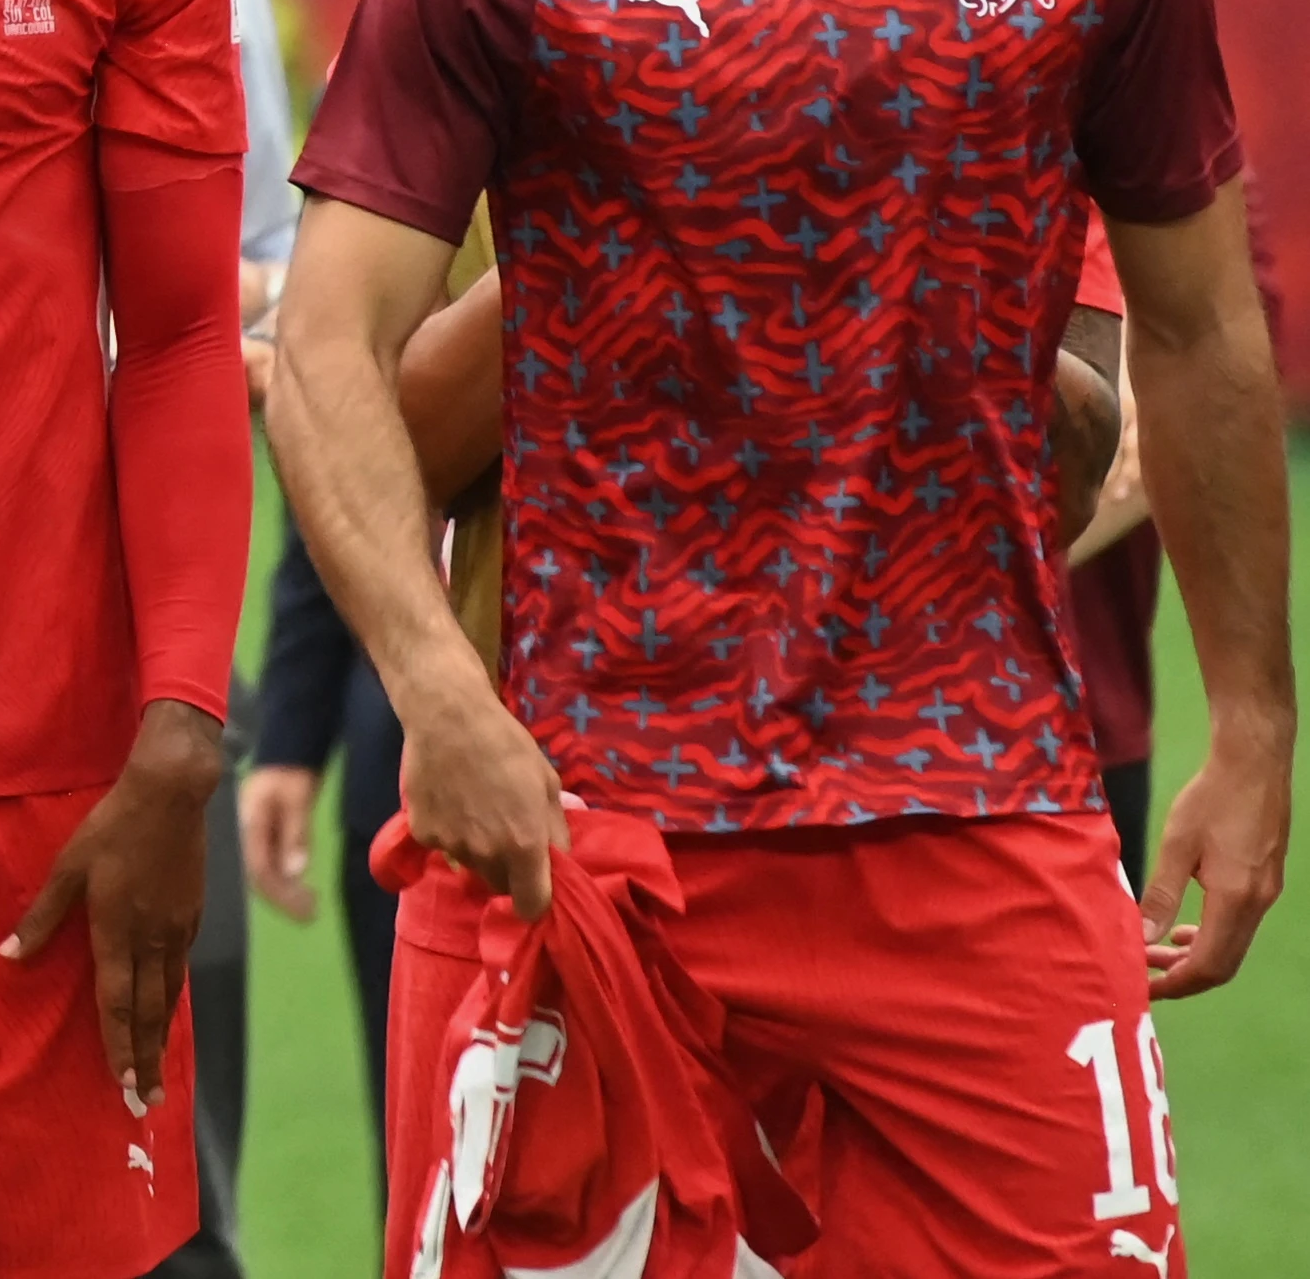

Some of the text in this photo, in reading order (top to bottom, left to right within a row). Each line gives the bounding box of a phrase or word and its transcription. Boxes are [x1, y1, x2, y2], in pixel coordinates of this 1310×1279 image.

[3, 6, 23, 23] SUI
[33, 5, 55, 22] COL
[1066, 1012, 1179, 1221] 18
